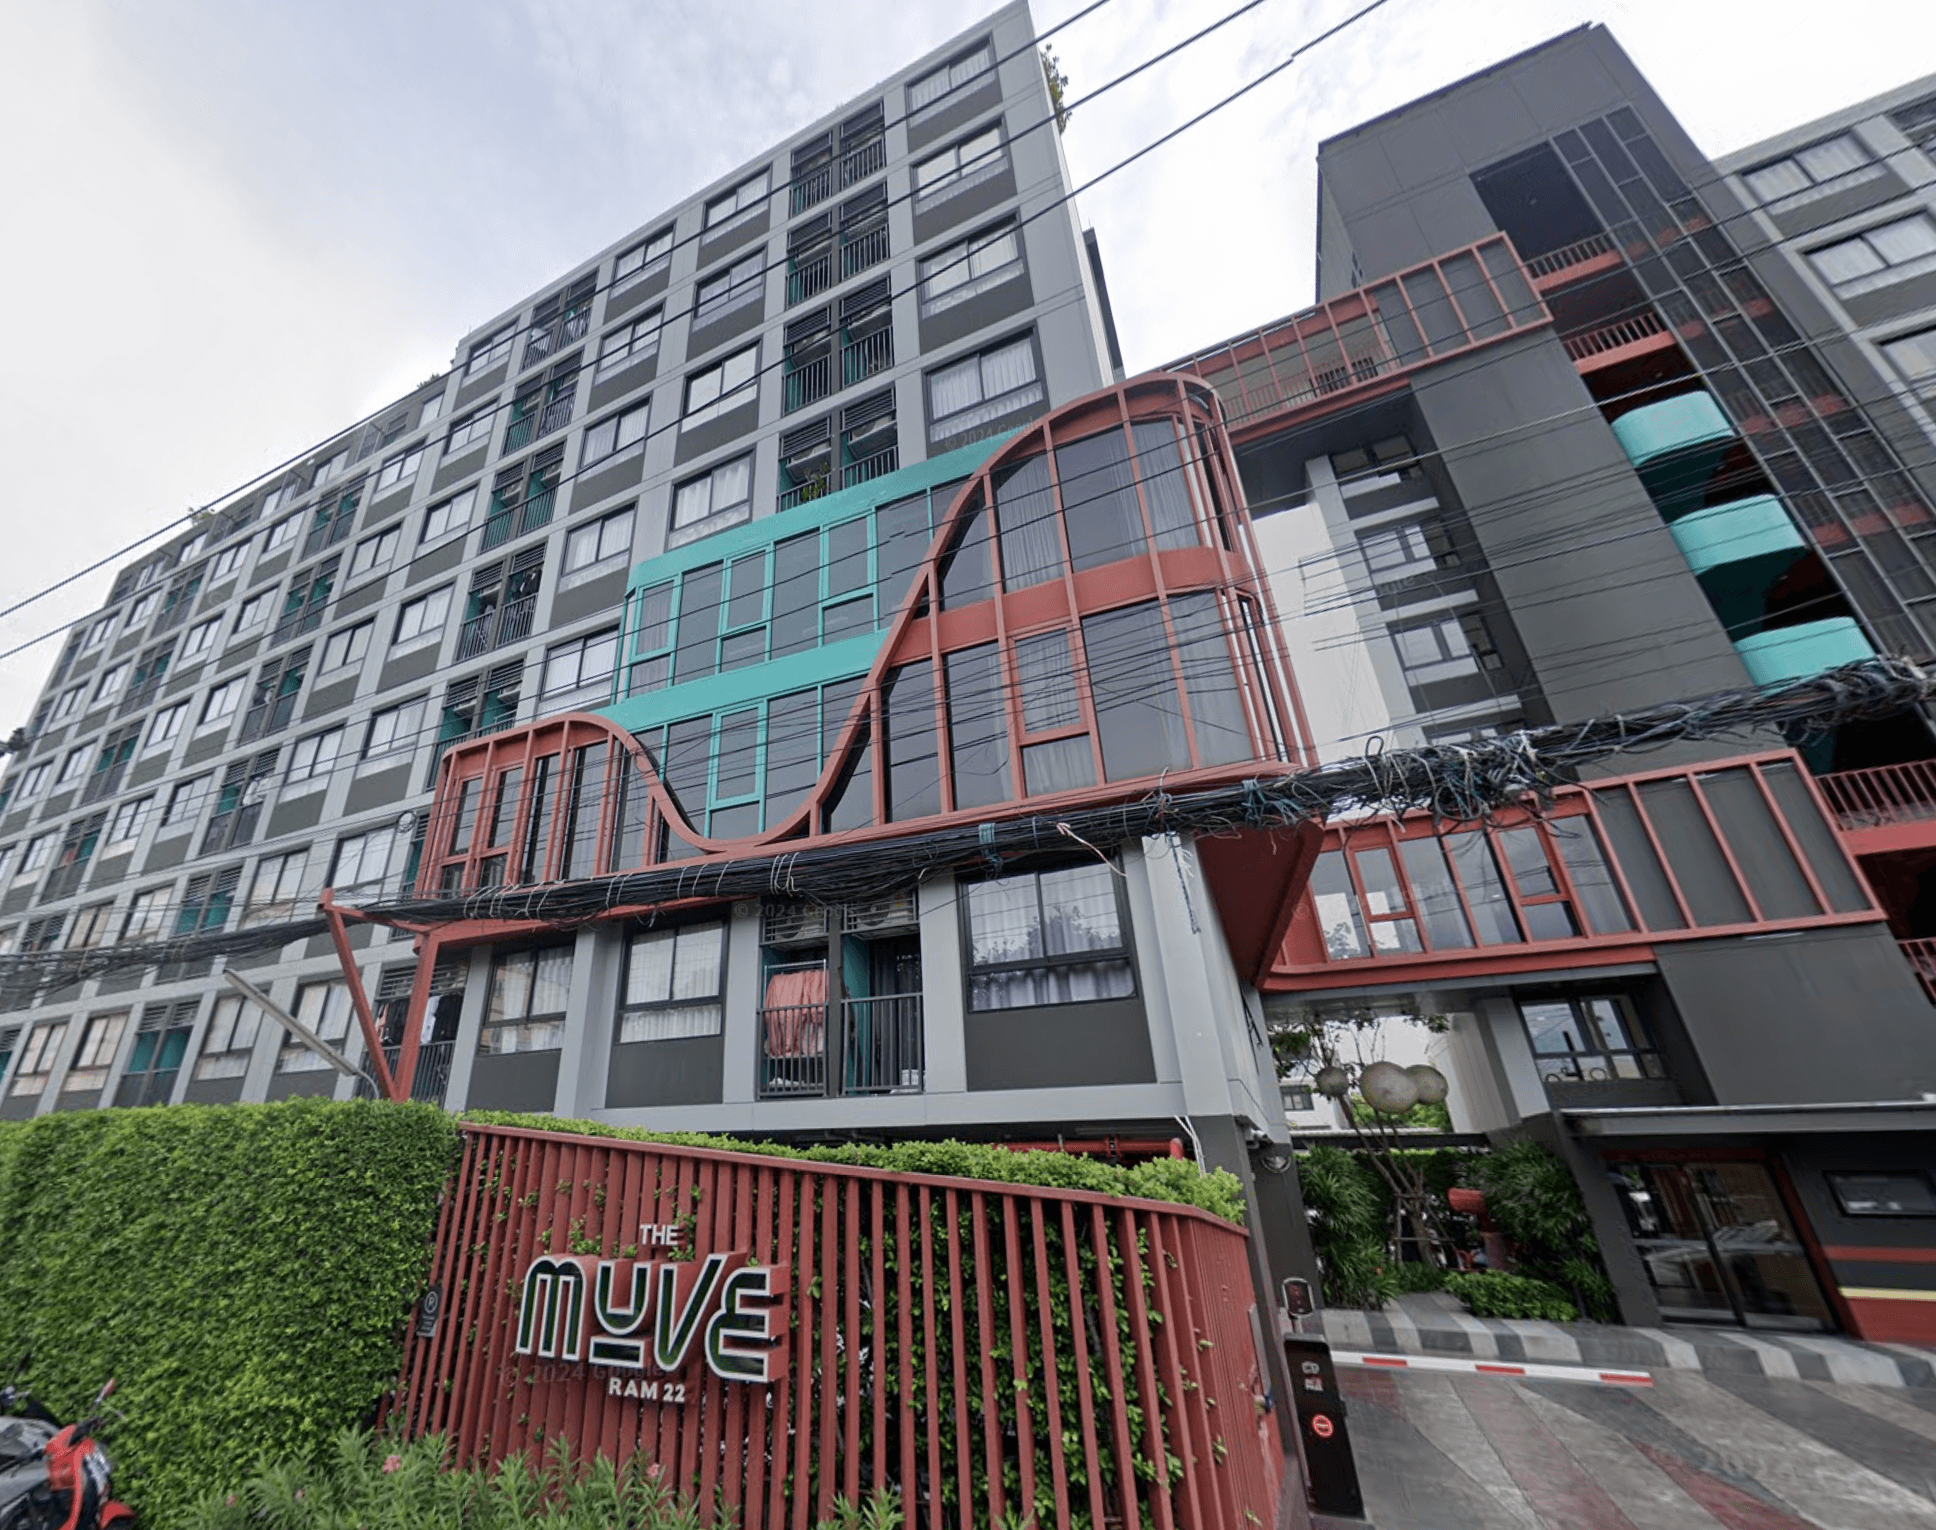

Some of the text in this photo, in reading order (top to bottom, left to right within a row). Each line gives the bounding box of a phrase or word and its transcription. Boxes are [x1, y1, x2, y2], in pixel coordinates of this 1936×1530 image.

[640, 1224, 680, 1246] THE
[608, 1377, 686, 1403] RAM 22
